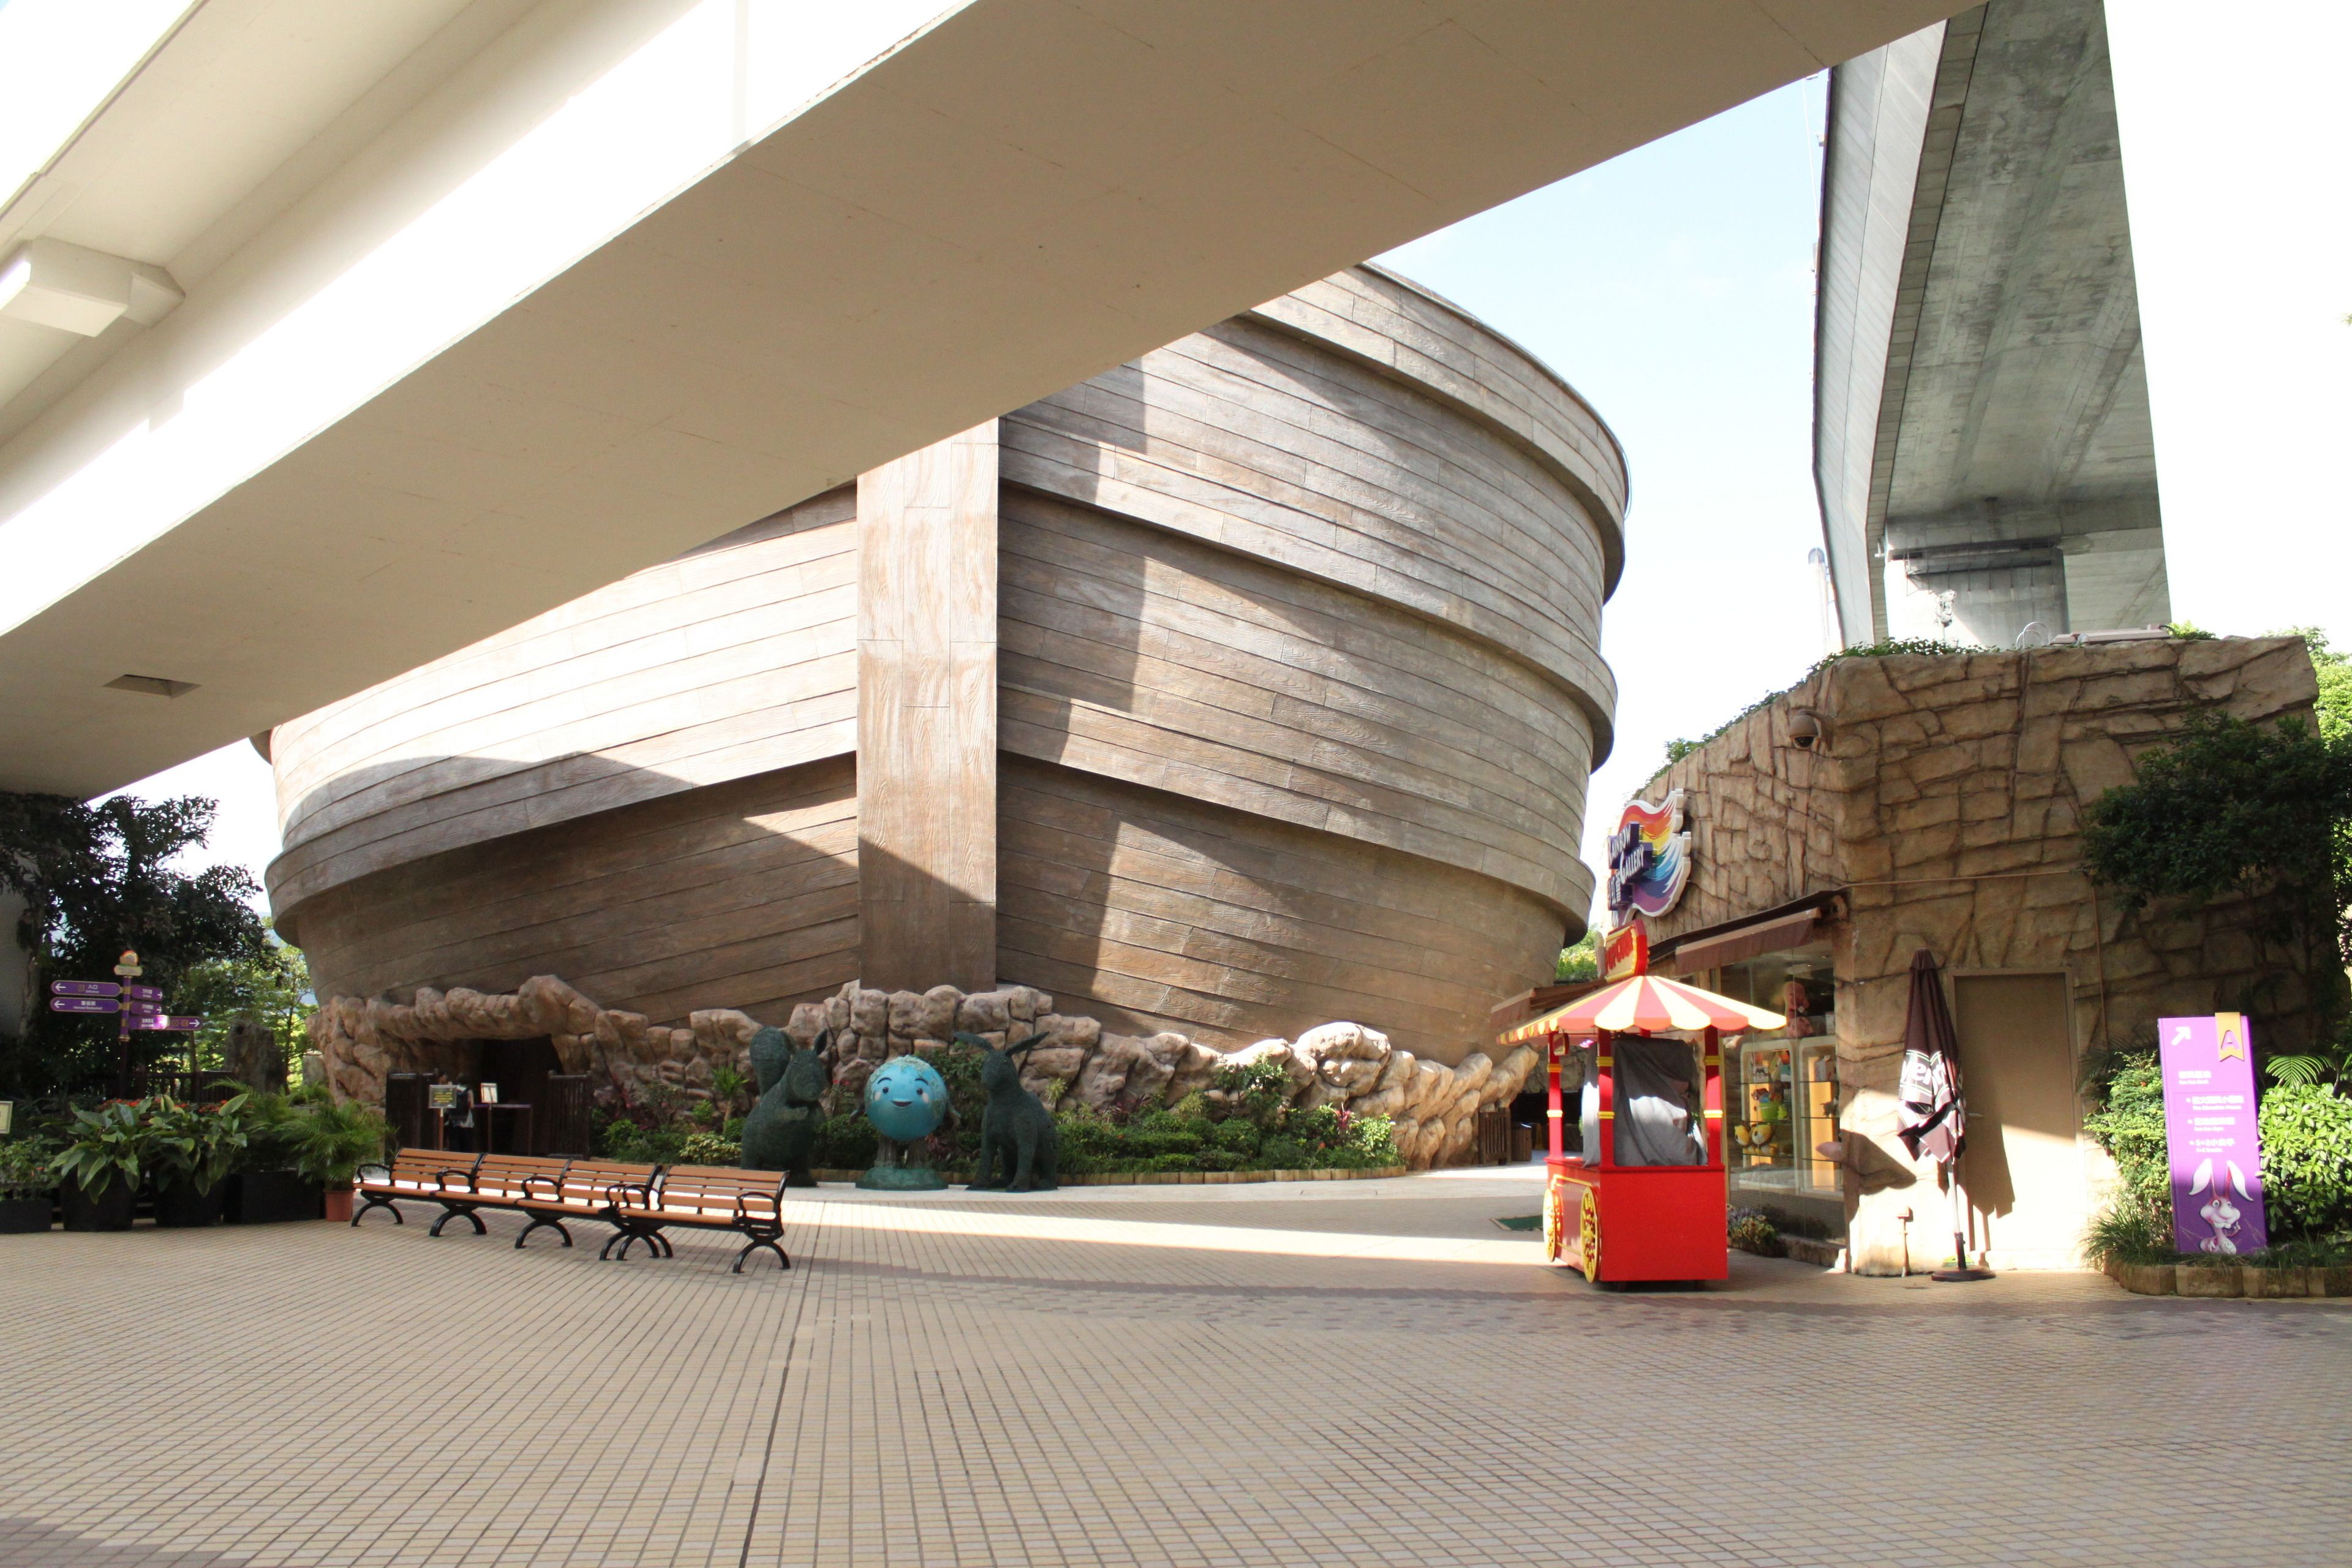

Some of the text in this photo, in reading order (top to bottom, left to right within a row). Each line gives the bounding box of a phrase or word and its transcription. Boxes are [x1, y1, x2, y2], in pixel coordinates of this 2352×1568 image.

[1607, 824, 1630, 868] RAINBOW
[1619, 844, 1644, 884] GALLERY
[2220, 1030, 2241, 1050] A
